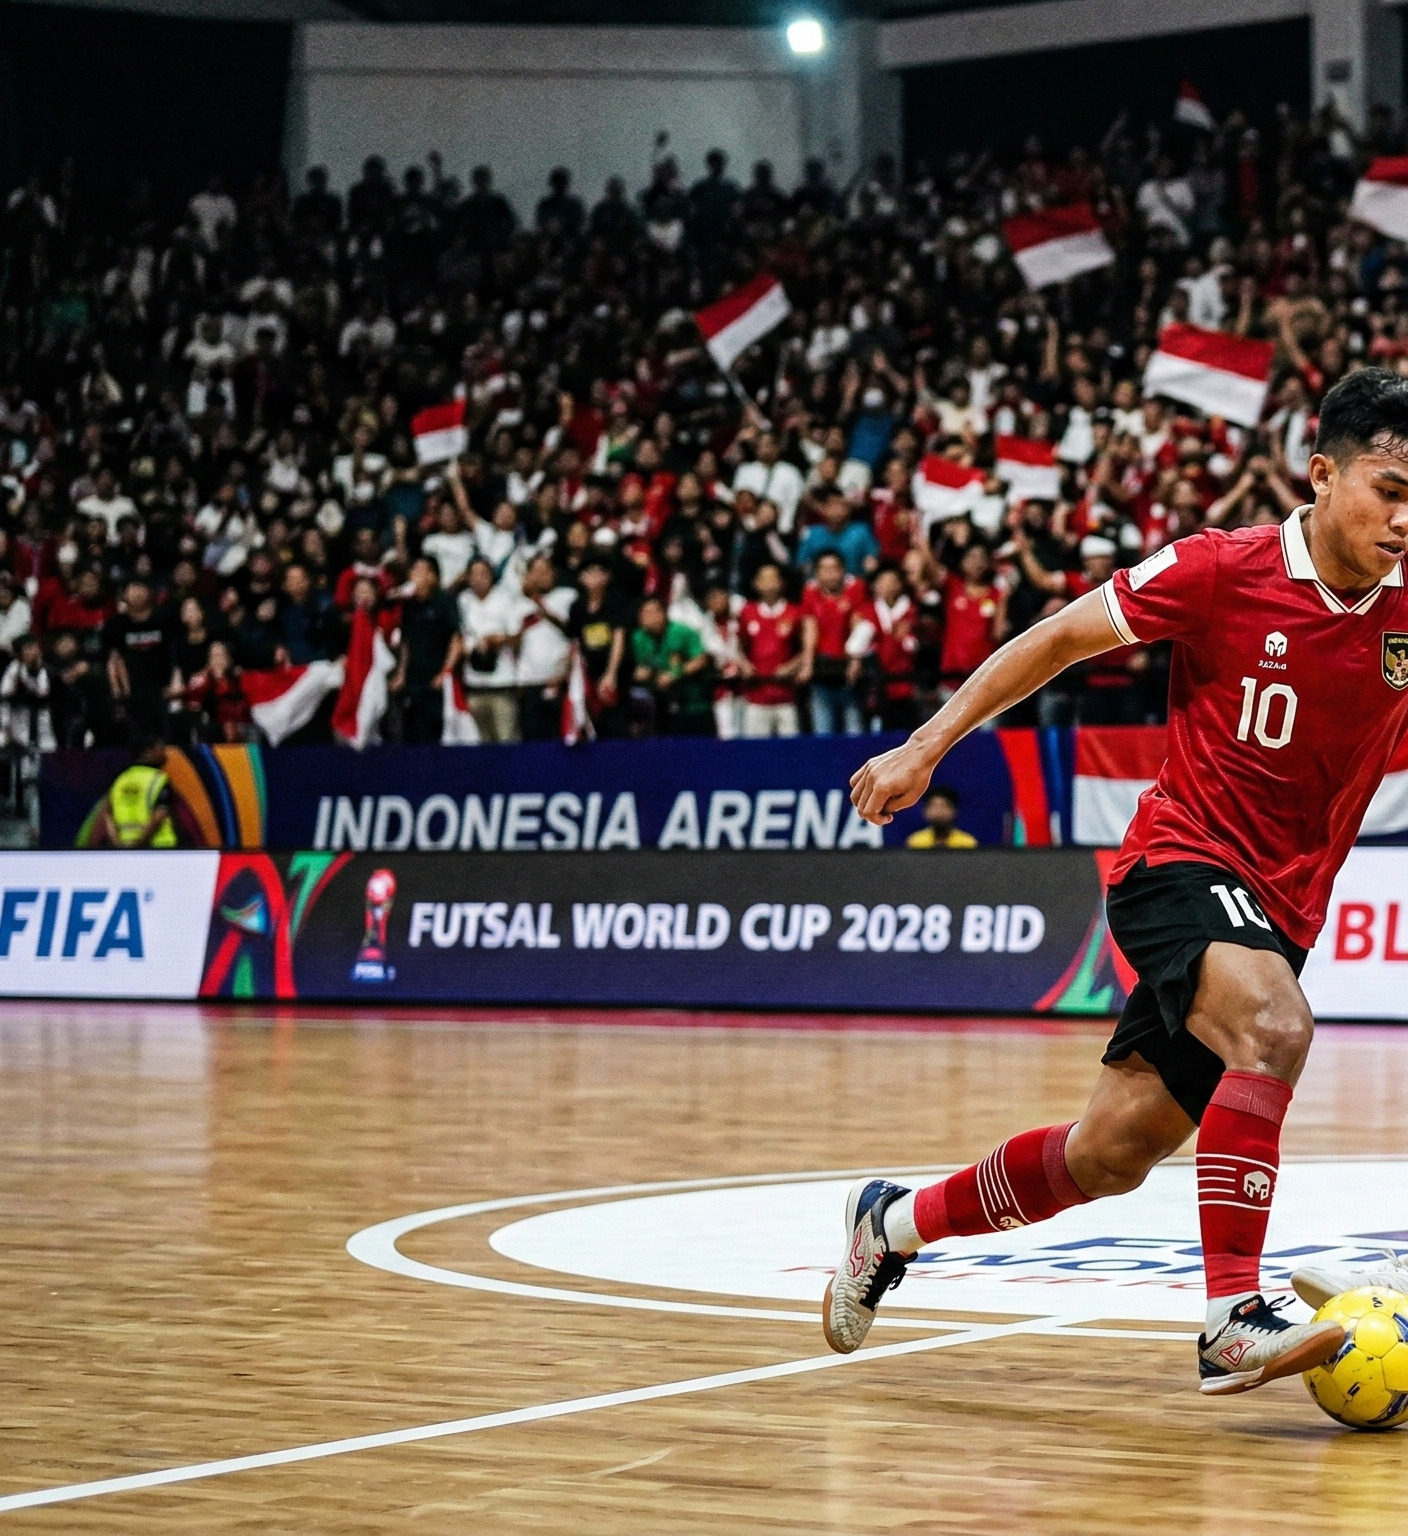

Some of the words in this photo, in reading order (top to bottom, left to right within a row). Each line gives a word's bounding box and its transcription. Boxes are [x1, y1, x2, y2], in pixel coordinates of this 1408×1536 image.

[1236, 677, 1298, 749] 10
[314, 791, 641, 850] INDONESIA
[0, 890, 145, 957] FIFA
[409, 903, 560, 948] FUTSAL
[572, 903, 731, 949] WORLD
[740, 903, 831, 951] CUP
[837, 904, 951, 952] 2028
[961, 905, 1046, 952] BID
